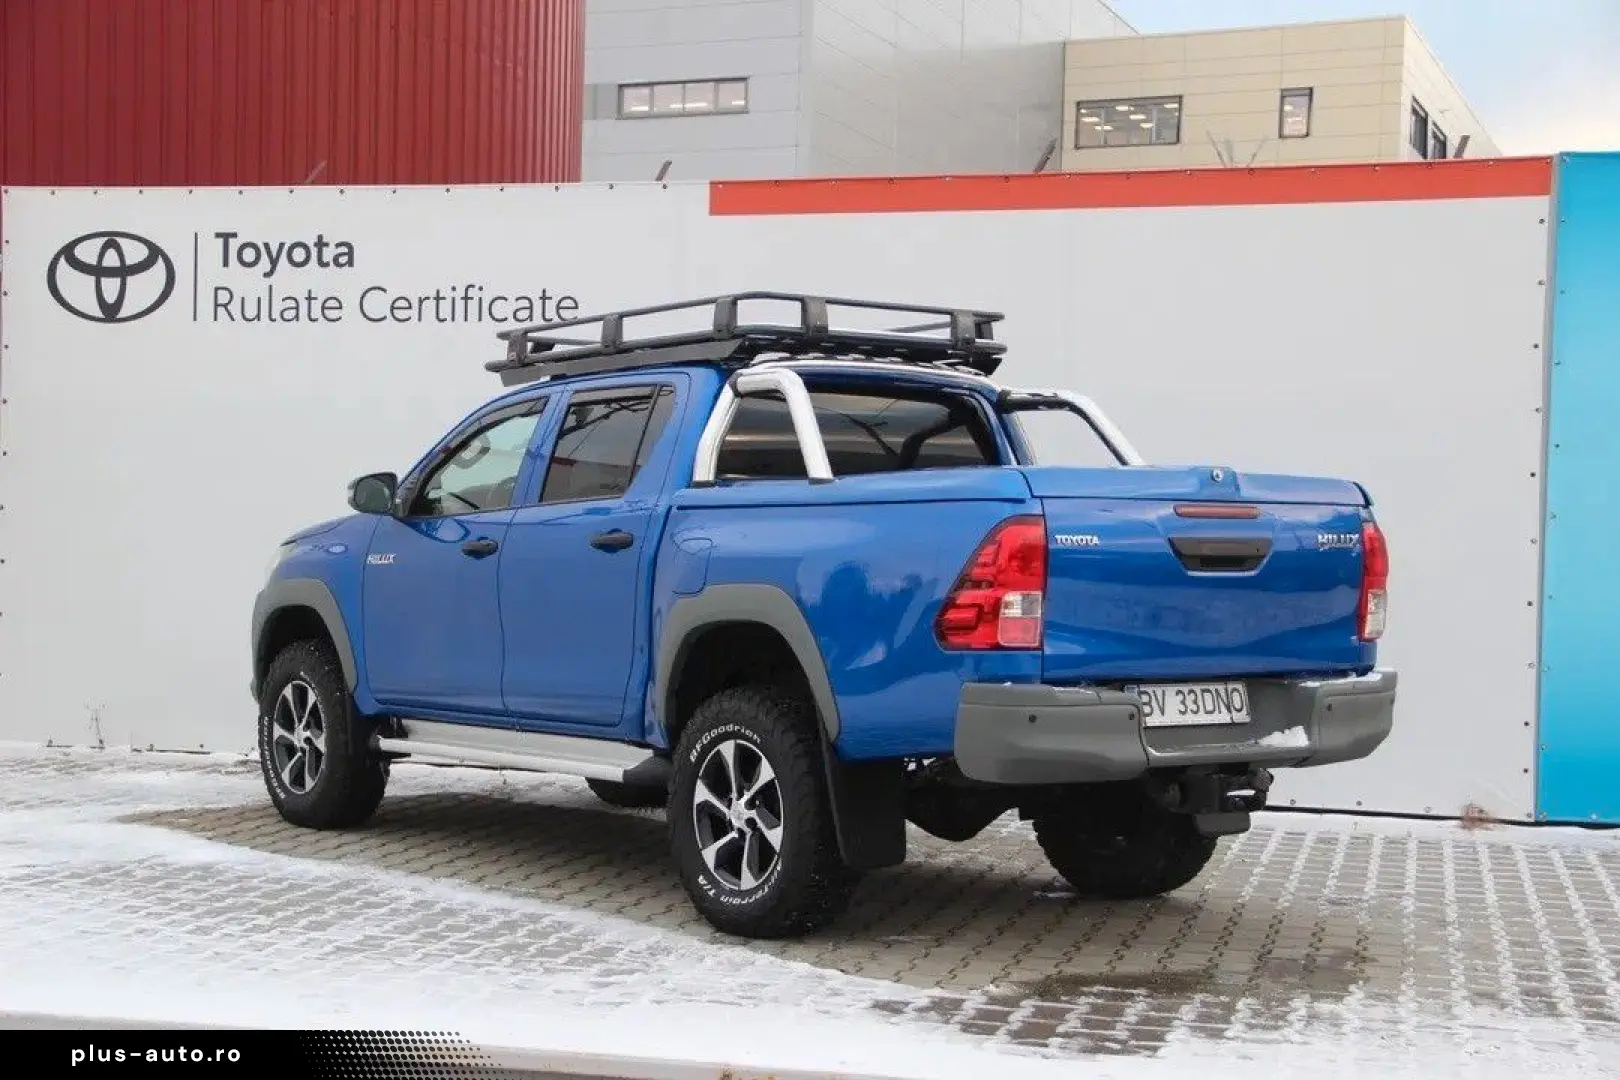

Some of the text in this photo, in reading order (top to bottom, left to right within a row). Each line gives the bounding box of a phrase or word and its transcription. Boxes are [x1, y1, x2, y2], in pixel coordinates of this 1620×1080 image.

[215, 232, 355, 278] Toyota
[213, 284, 580, 323] Rulate Certificate
[1054, 534, 1101, 546] TOYOTA
